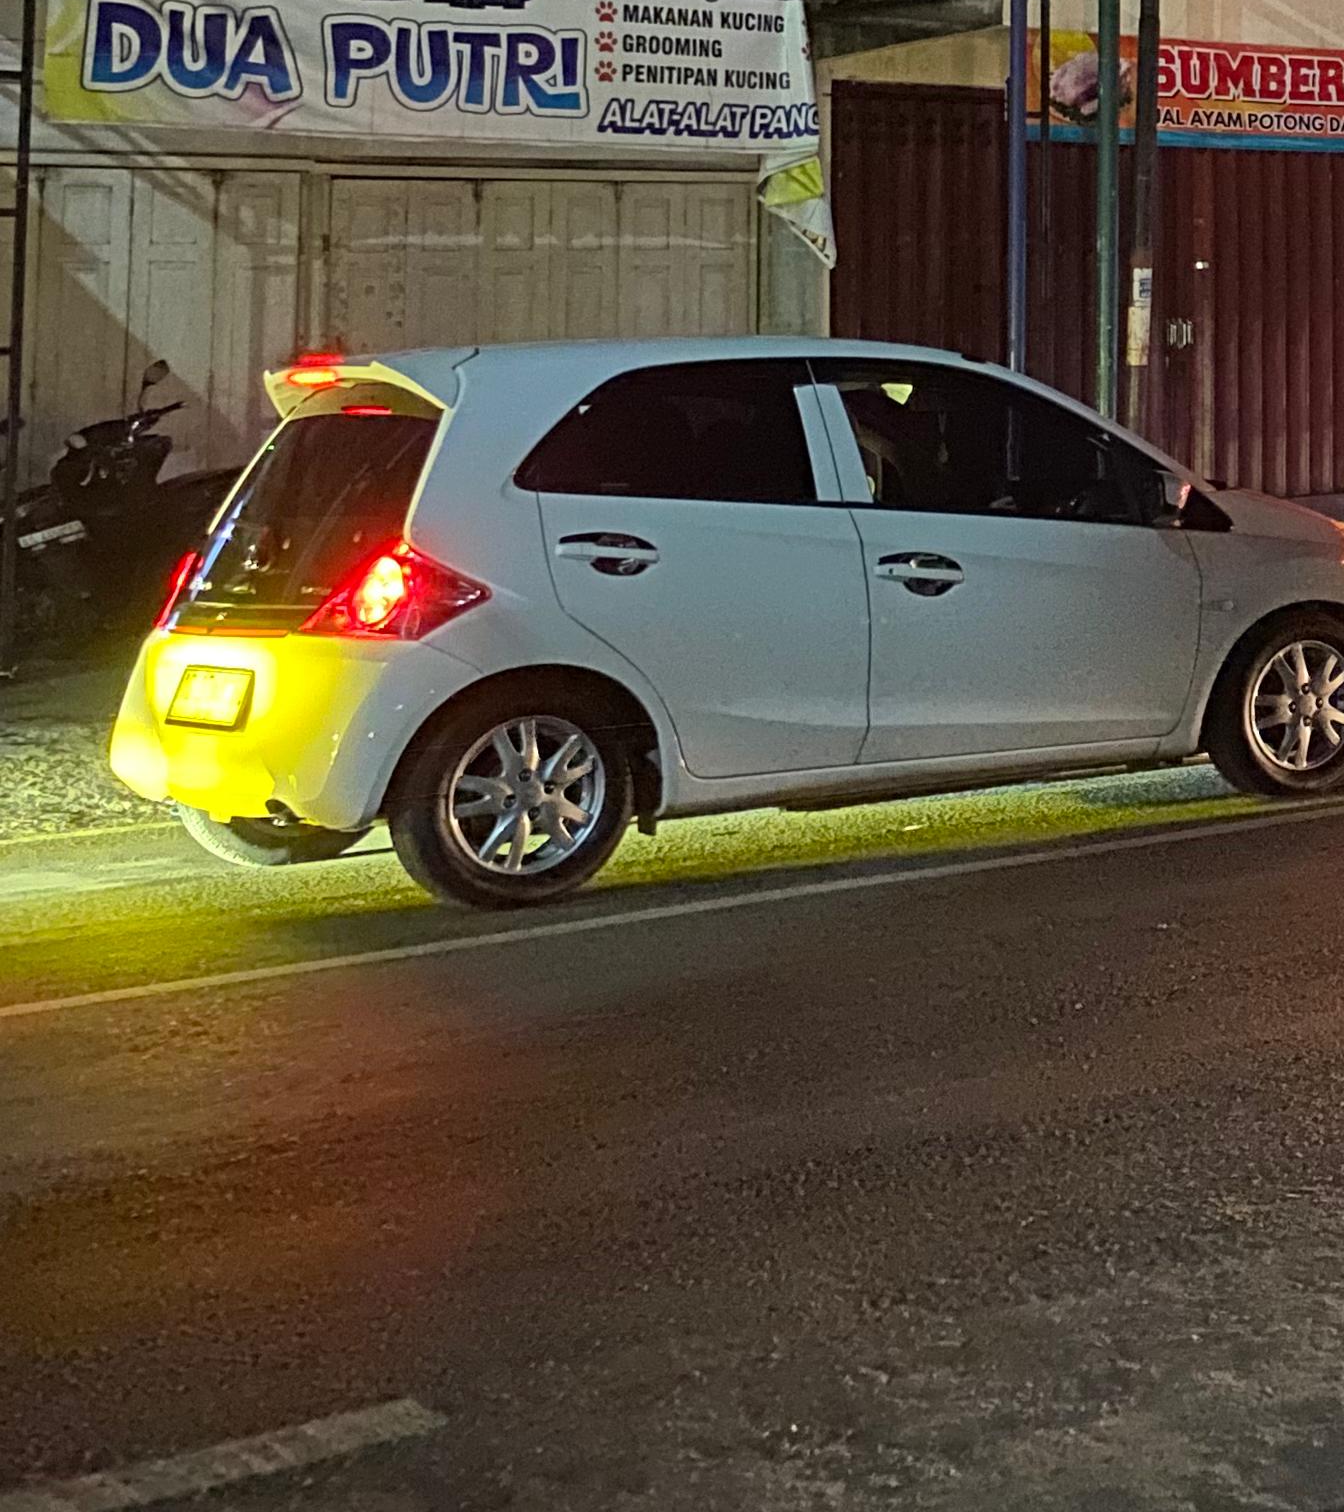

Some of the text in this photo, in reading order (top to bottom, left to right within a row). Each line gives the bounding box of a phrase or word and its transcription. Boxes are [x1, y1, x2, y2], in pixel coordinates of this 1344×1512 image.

[622, 4, 785, 33] MAKANAN KUCING
[622, 34, 722, 58] GROOMING
[621, 64, 791, 90] PENITIPAN KUCING
[600, 99, 748, 135] ALAT-ALAT
[1190, 110, 1243, 128] AYAM
[1248, 113, 1324, 131] POTONG
